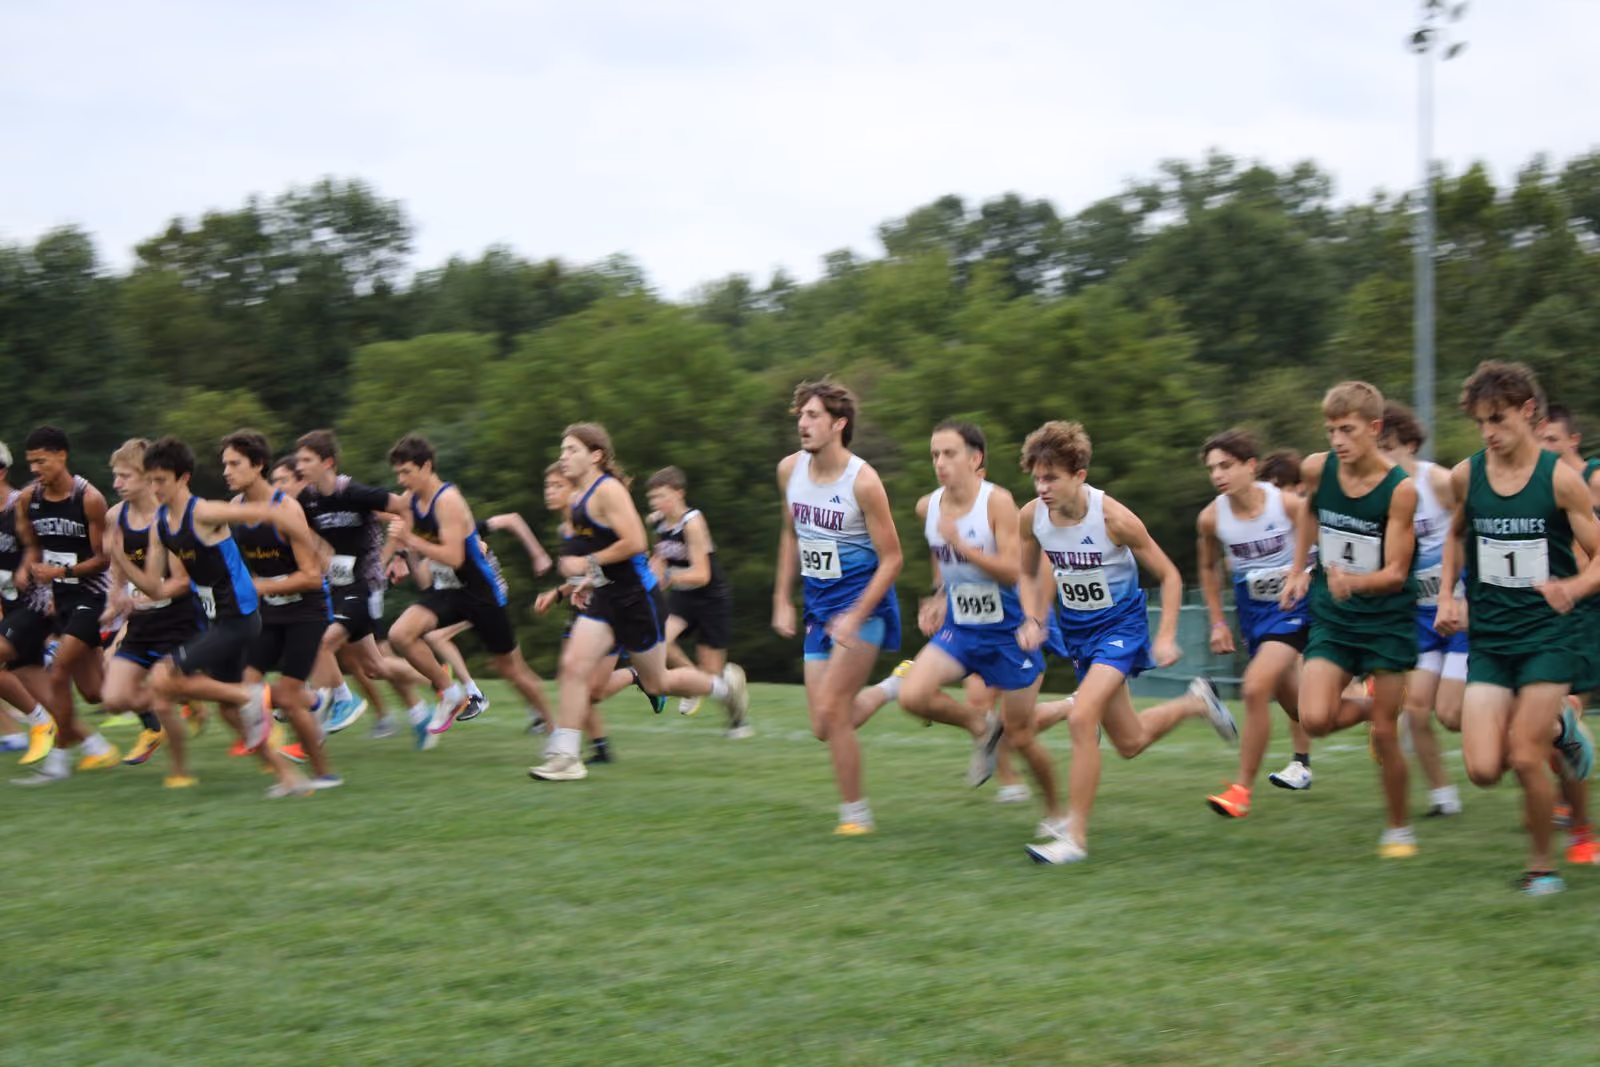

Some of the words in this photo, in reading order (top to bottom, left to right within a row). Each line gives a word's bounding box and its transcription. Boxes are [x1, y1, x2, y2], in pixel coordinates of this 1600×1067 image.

[813, 506, 845, 532] VALLEY
[803, 549, 833, 571] 997
[1342, 541, 1353, 564] 4
[1504, 551, 1516, 577] 1
[1062, 581, 1105, 603] 996
[956, 593, 997, 616] 995
